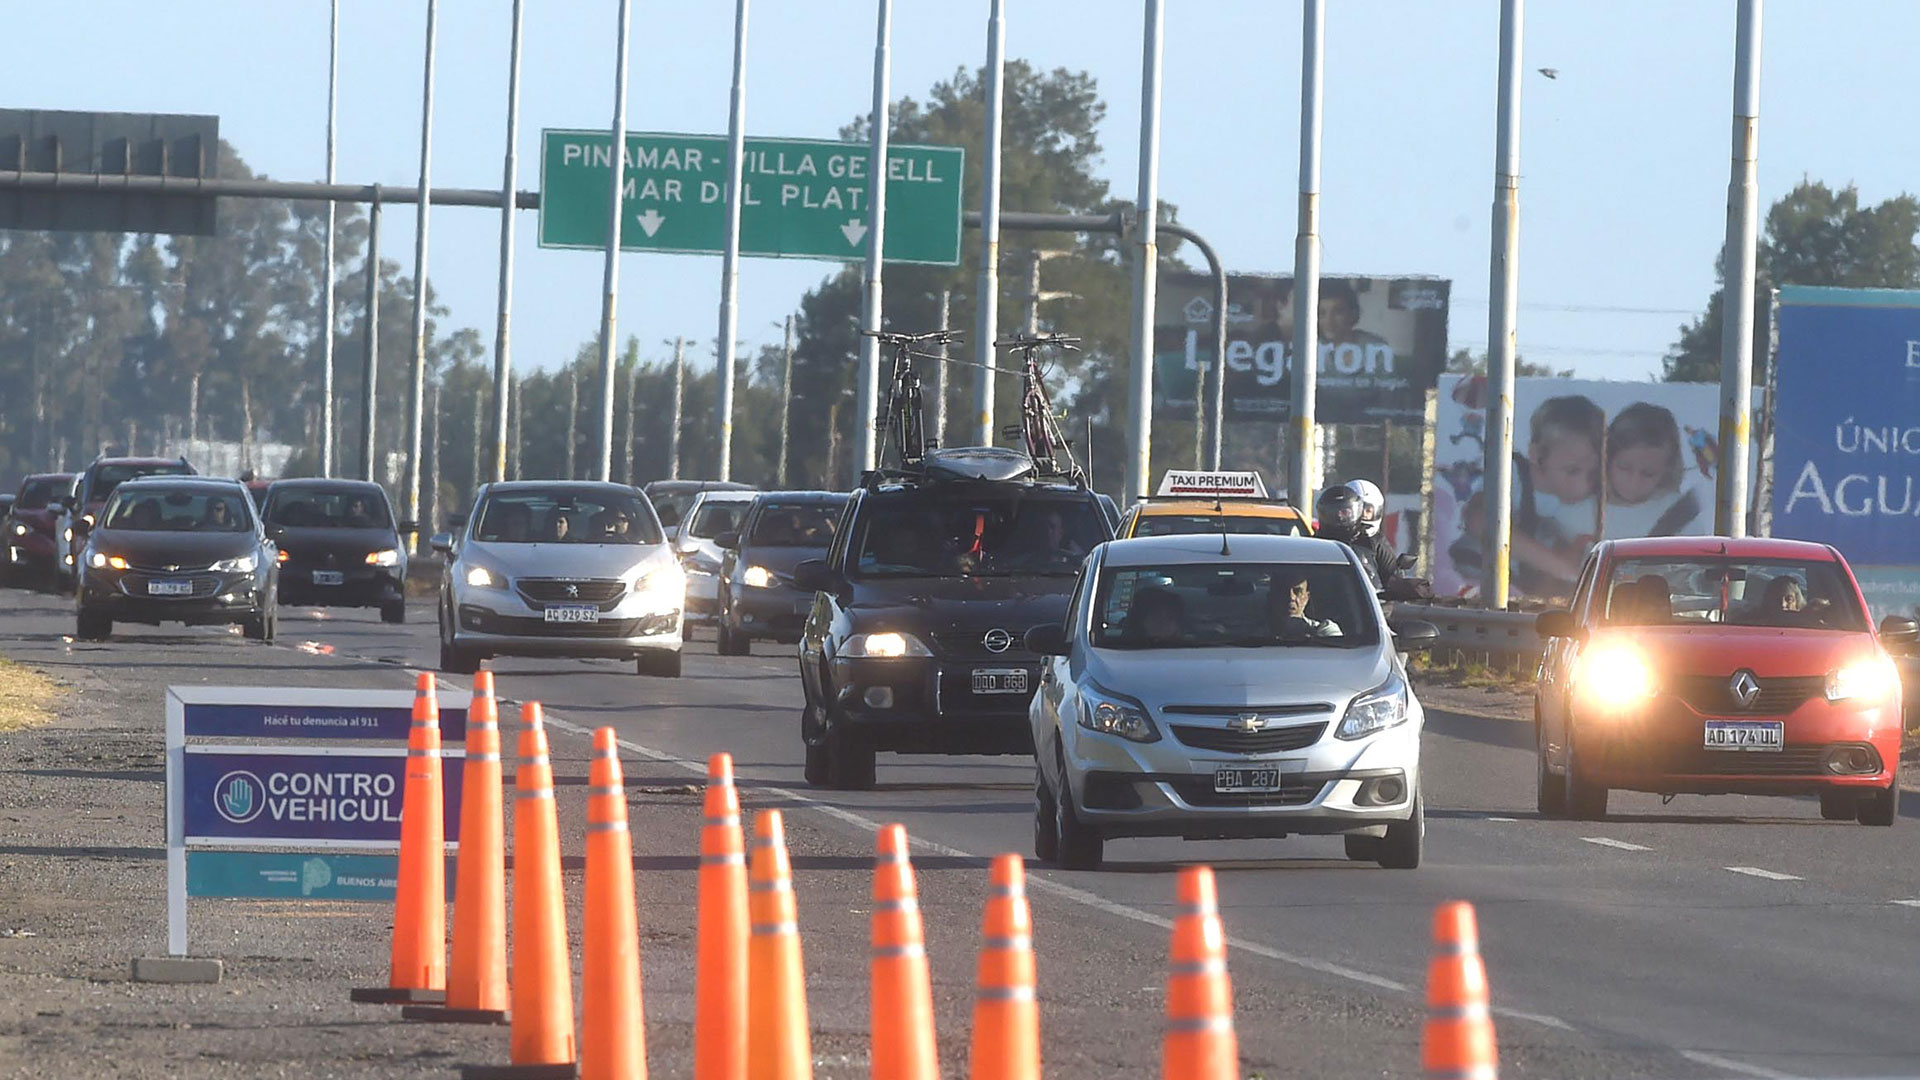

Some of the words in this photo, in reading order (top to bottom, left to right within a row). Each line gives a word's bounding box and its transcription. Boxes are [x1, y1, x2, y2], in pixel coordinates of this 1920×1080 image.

[742, 151, 818, 177] ILLA
[827, 154, 944, 183] GEELL
[700, 181, 762, 206] DL
[781, 184, 887, 212] PLAT
[1170, 475, 1196, 486] TAXI
[1199, 476, 1255, 487] PREMIUM
[1784, 459, 1920, 517] AGU
[562, 609, 581, 620] 929
[290, 715, 301, 726] tu
[302, 715, 348, 727] denuncia
[349, 716, 360, 727] al
[361, 716, 380, 727] 911
[1708, 729, 1726, 744] AD
[1730, 729, 1757, 745] 174
[1761, 729, 1778, 745] UL
[1217, 770, 1244, 787] PBA
[1251, 770, 1278, 787] 287
[268, 797, 405, 822] VEHICUL
[337, 875, 376, 888] BUENOS
